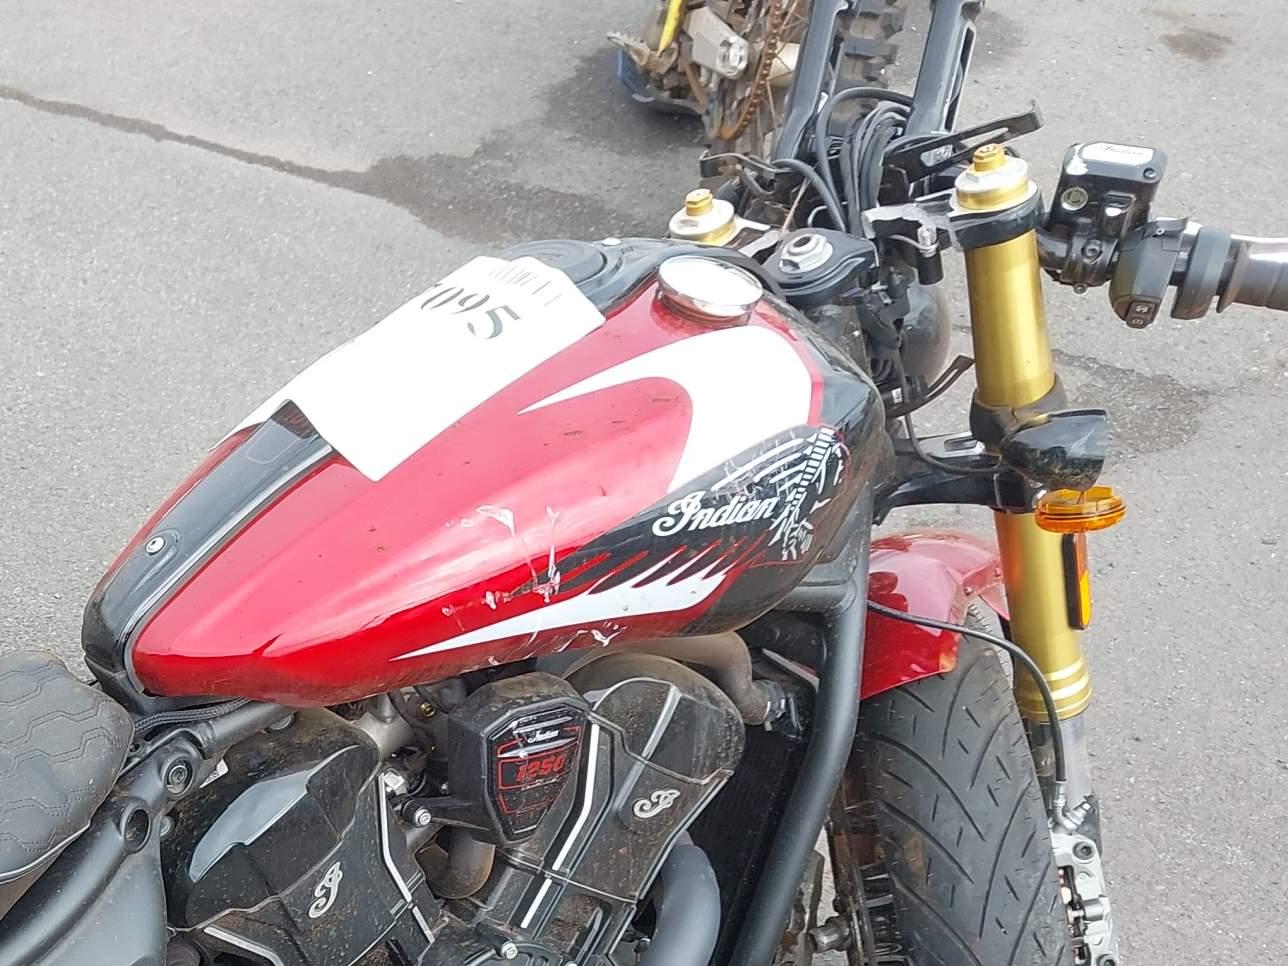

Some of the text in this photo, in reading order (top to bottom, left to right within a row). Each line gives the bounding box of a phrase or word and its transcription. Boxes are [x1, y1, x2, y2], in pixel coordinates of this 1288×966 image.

[421, 282, 521, 340] 095
[652, 491, 780, 537] Indian
[527, 729, 560, 744] Indian
[515, 753, 567, 782] 1250
